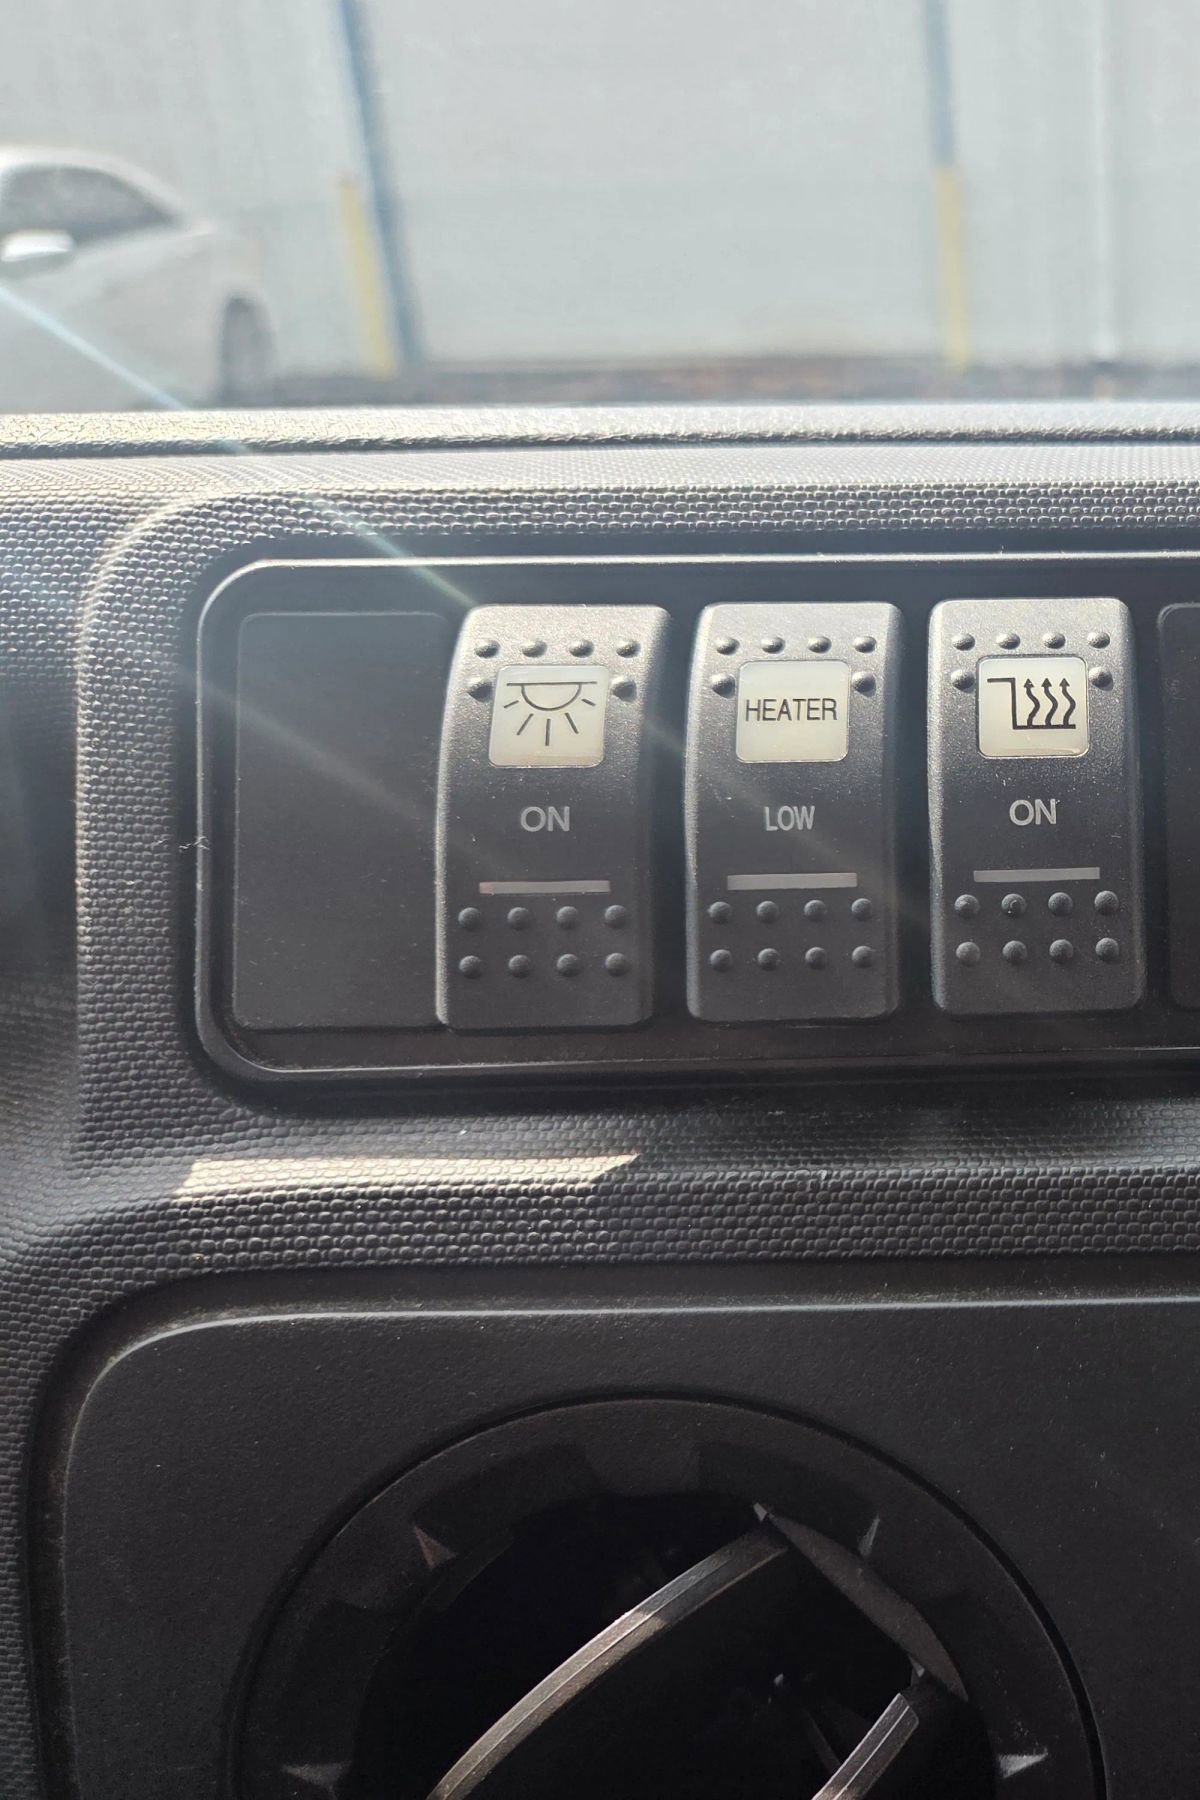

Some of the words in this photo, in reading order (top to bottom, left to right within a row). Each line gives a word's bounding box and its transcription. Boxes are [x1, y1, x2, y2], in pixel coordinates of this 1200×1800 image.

[745, 697, 838, 722] HEATER
[520, 805, 571, 833] ON
[764, 805, 816, 832] LOW
[1009, 798, 1057, 826] ON
